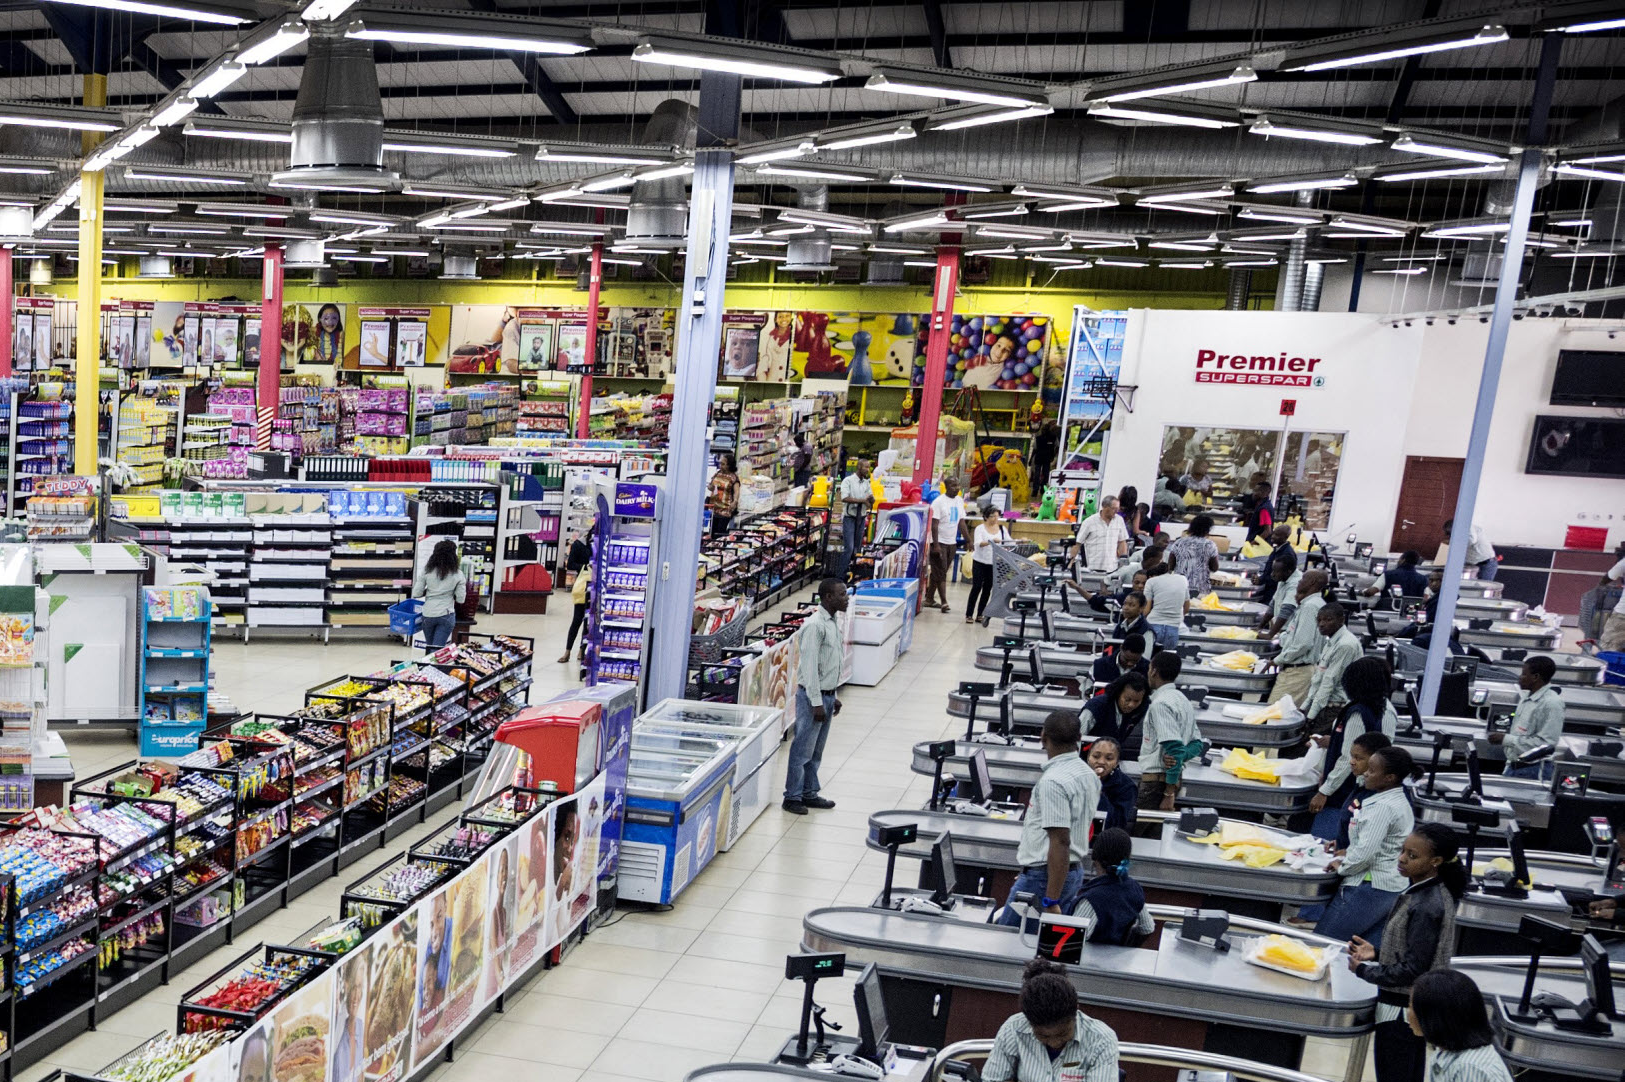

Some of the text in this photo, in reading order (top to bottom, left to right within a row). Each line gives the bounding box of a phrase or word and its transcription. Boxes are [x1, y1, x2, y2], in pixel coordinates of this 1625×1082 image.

[1196, 350, 1322, 372] Premier
[1199, 373, 1308, 386] SUPERSPAR
[45, 479, 88, 493] TEDDY
[636, 496, 654, 504] MILK
[1050, 924, 1076, 957] 7
